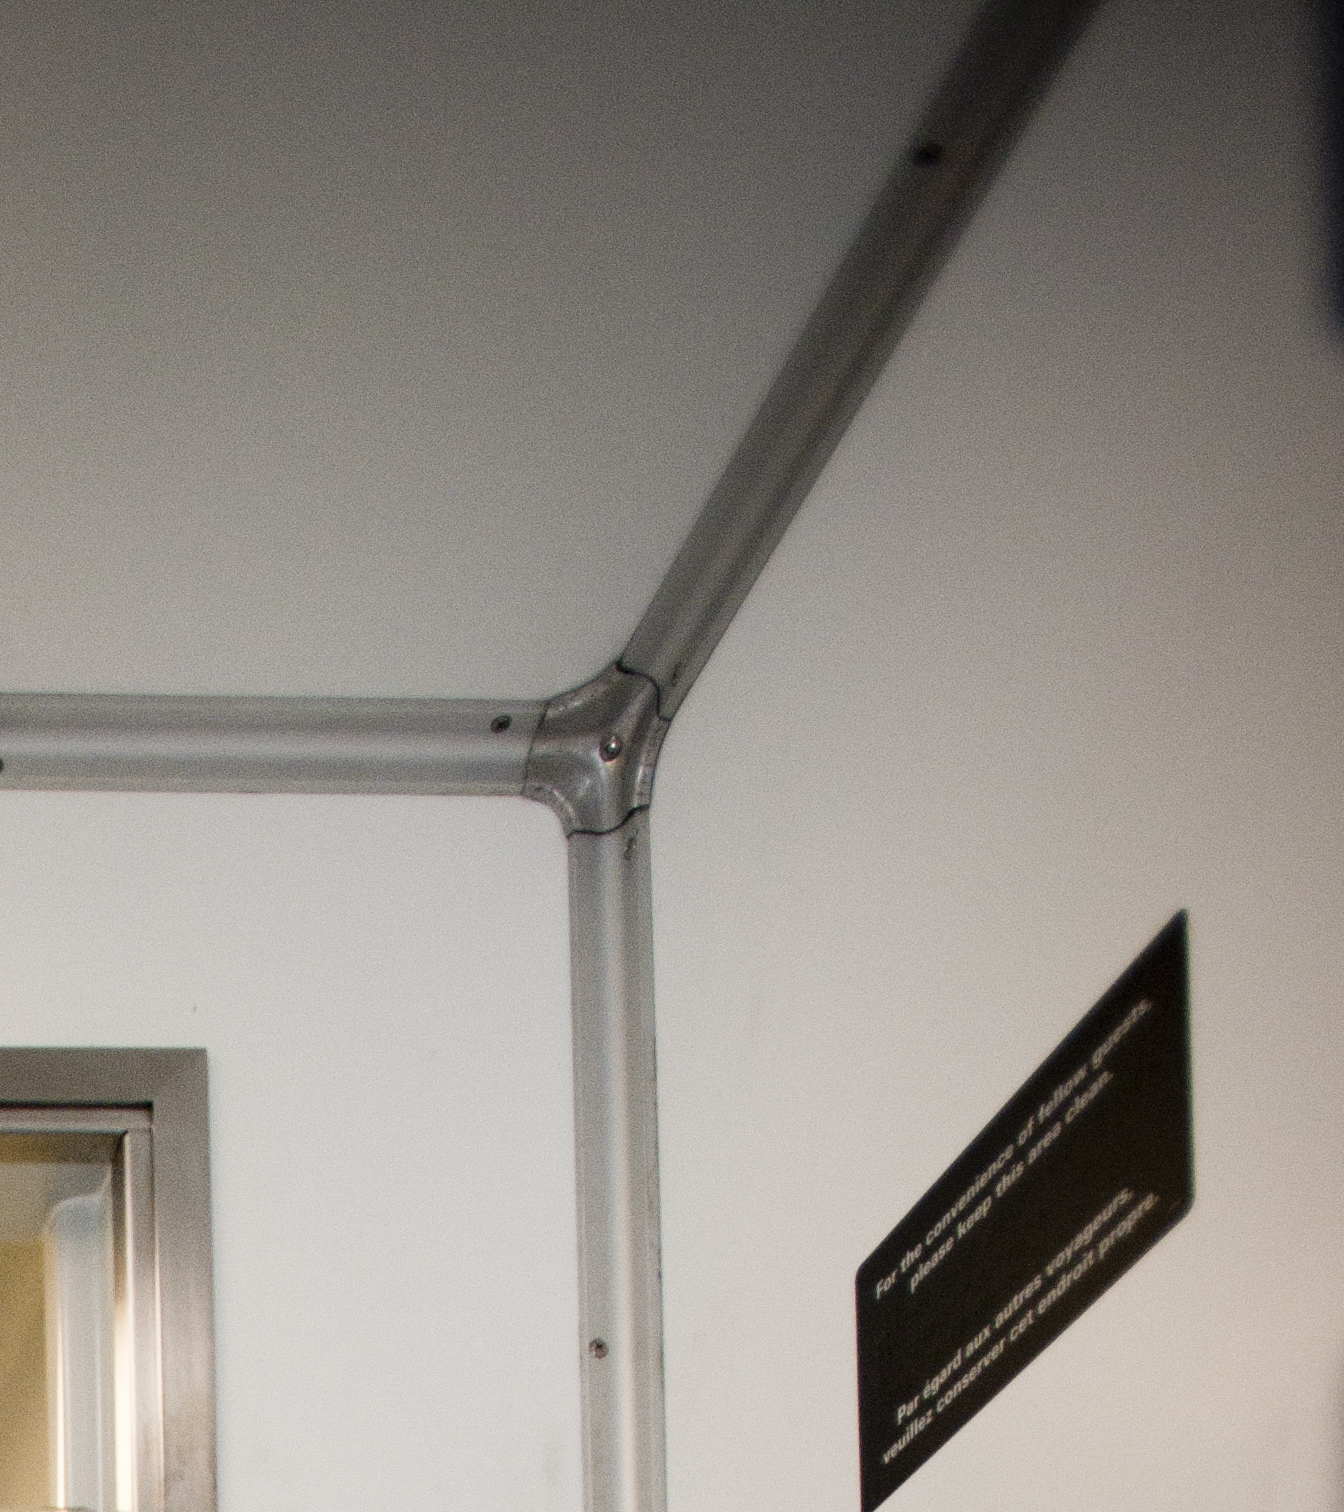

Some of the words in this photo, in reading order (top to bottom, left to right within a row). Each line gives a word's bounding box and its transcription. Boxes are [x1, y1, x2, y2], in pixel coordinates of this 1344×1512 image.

[874, 1270, 898, 1300] For
[899, 1242, 923, 1274] the
[924, 1143, 1014, 1246] convenience
[1017, 1114, 1036, 1147] of
[1038, 1062, 1089, 1124] fellow
[909, 1236, 955, 1294] please
[957, 1194, 994, 1240] keep
[995, 1160, 1026, 1198] this
[1027, 1120, 1063, 1165] area
[1065, 1070, 1114, 1124] clean.
[881, 1408, 935, 1465] veuillez
[936, 1336, 1007, 1413] conserver
[1009, 1308, 1036, 1342] cet
[1037, 1250, 1097, 1315] endroit
[1098, 1191, 1160, 1260] propre.
[897, 1393, 921, 1425] Par
[922, 1347, 963, 1399] égard
[964, 1323, 992, 1358] aux
[994, 1273, 1043, 1329] autres
